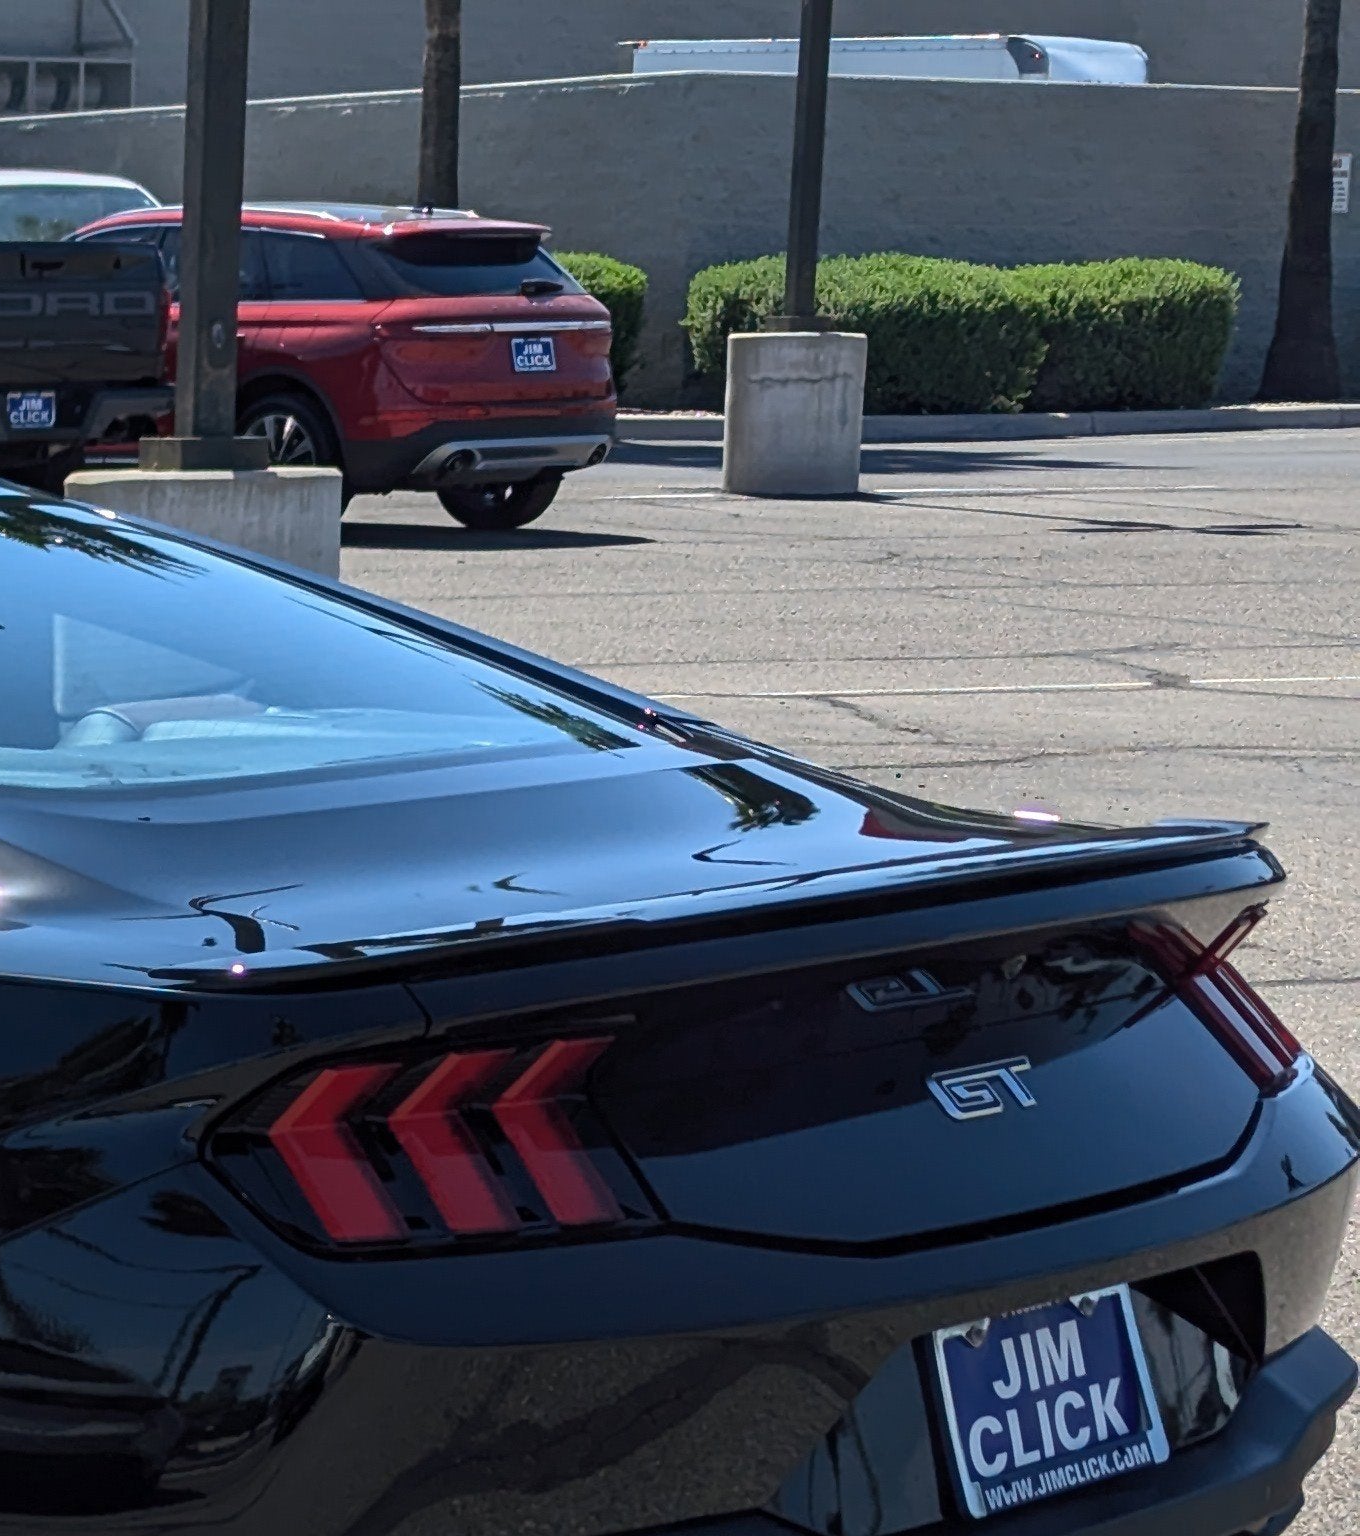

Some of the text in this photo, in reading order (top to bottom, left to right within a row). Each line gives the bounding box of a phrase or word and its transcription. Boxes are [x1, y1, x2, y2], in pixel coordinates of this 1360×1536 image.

[516, 354, 551, 367] CLICK
[522, 343, 544, 355] JIM
[10, 410, 49, 424] CLICK
[18, 398, 43, 411] JIM
[926, 1055, 1038, 1120] GT
[992, 1319, 1087, 1400] JIM
[968, 1377, 1131, 1478] CLICK
[984, 1441, 1151, 1511] WWW.JIMCLICK.COM
